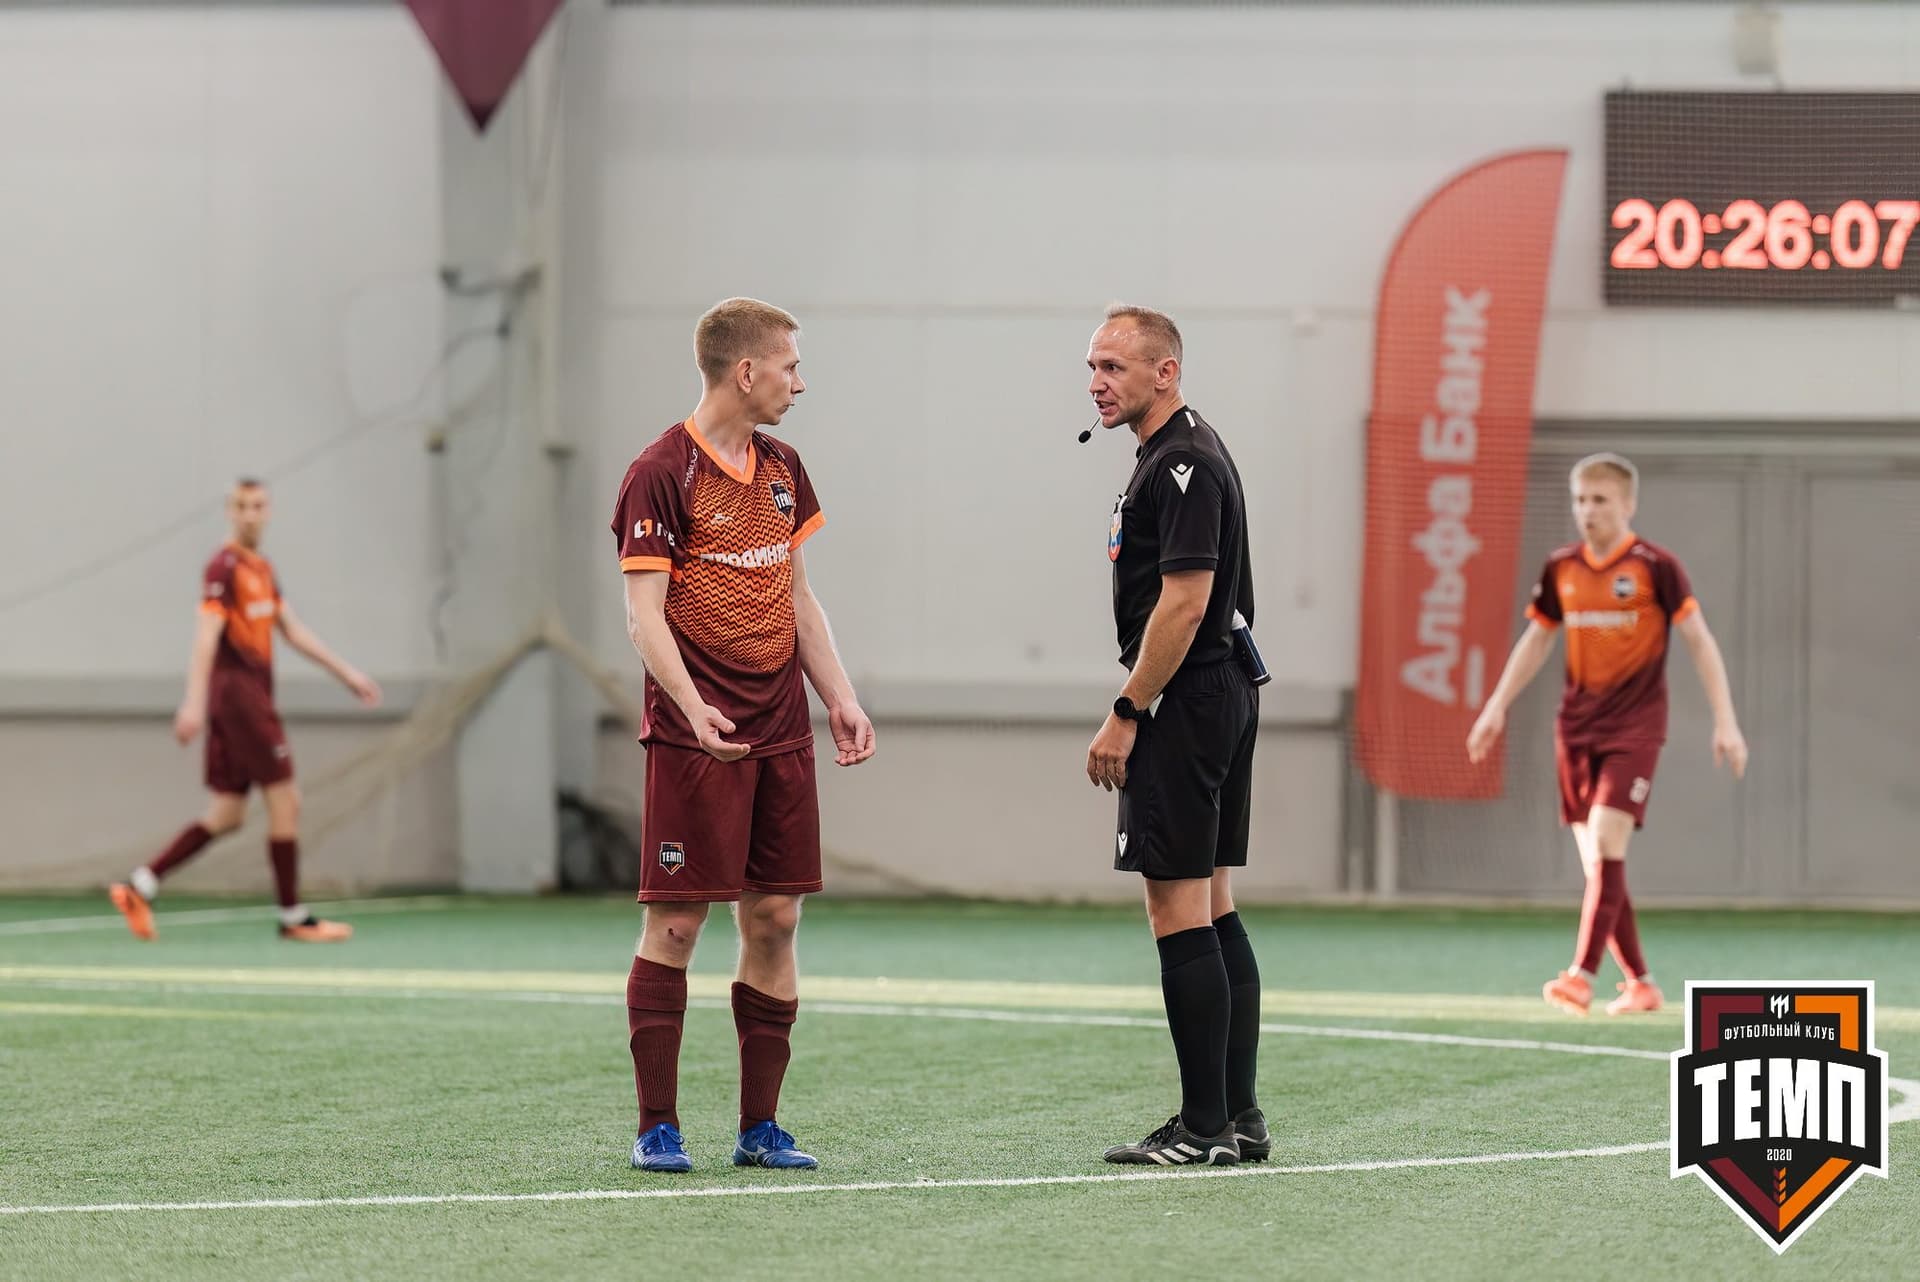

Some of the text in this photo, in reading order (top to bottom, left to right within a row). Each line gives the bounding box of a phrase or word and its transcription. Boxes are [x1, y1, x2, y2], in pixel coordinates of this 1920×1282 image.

[1610, 198, 1920, 270] 20:26:07
[1401, 286, 1491, 704] Альфа Банк
